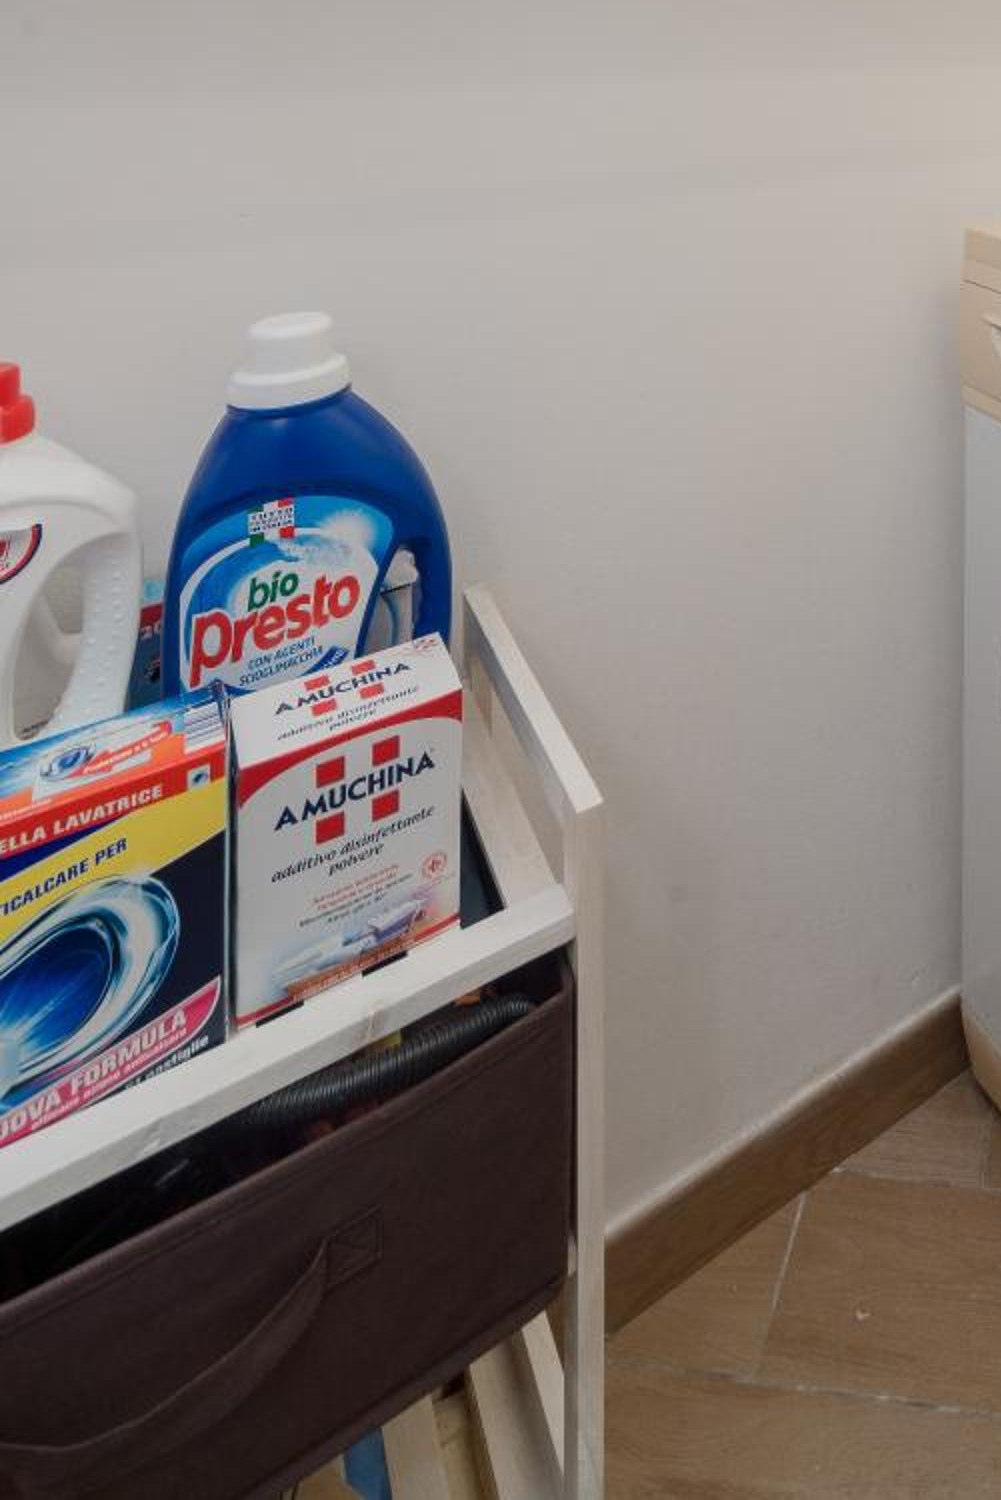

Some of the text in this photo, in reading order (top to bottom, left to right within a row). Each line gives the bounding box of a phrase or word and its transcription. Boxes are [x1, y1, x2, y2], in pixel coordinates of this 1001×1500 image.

[248, 571, 299, 612] bio
[189, 574, 361, 689] presto
[274, 662, 410, 716] AMUCHINA
[52, 784, 163, 834] LAVATRICE
[273, 751, 436, 832] AMUCHINA
[0, 837, 128, 916] ICALCARE PER
[271, 806, 435, 883] additivo disinfettante
[327, 844, 385, 876] polvere
[69, 1008, 188, 1096] FORMULA
